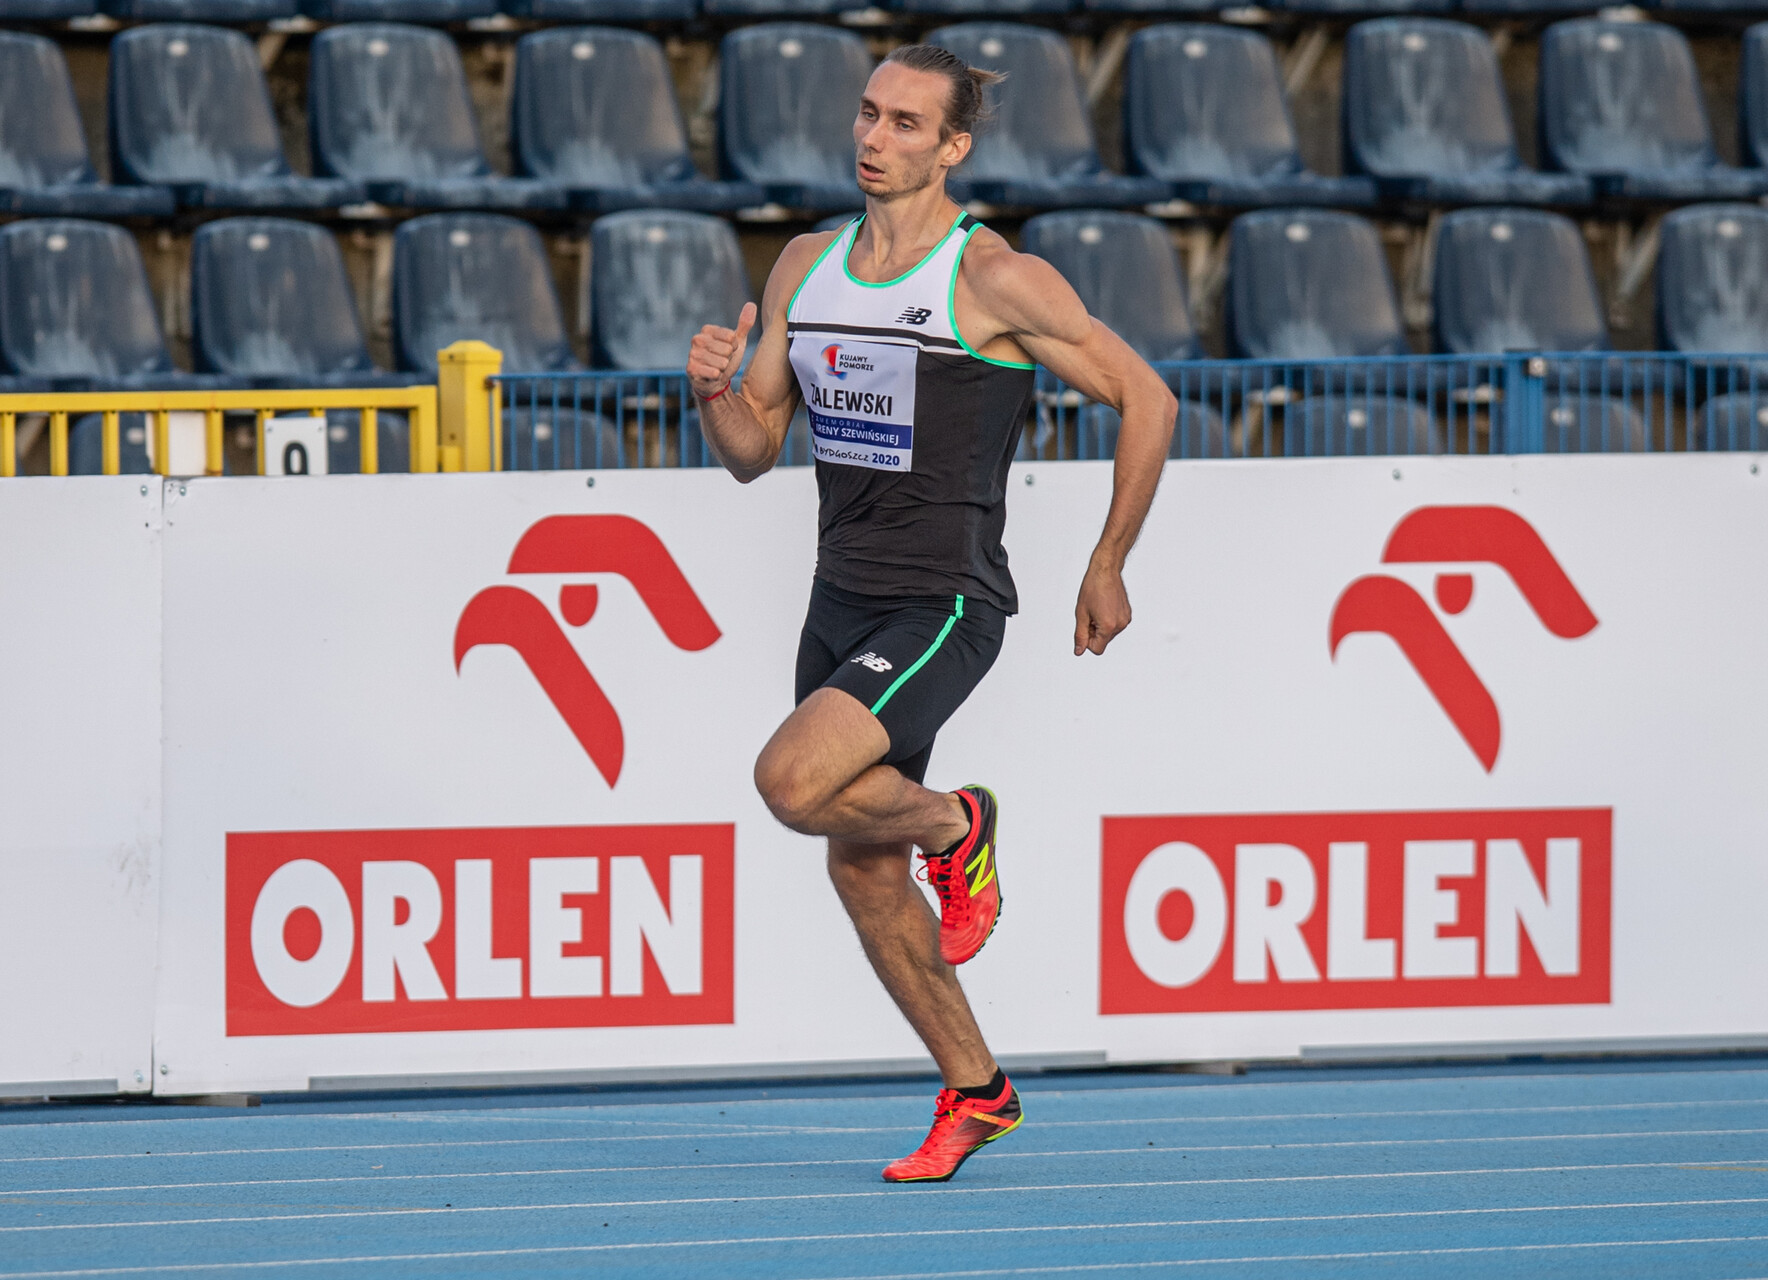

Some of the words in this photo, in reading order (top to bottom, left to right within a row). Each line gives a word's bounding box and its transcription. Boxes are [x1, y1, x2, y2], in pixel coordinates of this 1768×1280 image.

[839, 353, 868, 363] KUJAWY
[839, 361, 875, 371] POMORZE
[810, 382, 893, 416] ZALEWSKI
[815, 423, 839, 436] IRENY
[841, 427, 899, 446] SZEWIŃSKIEJ
[820, 446, 869, 462] BYDGOSZCZ
[872, 453, 900, 466] 2020
[1125, 839, 1579, 986] ORLEN
[252, 856, 702, 1006] ORLEN
